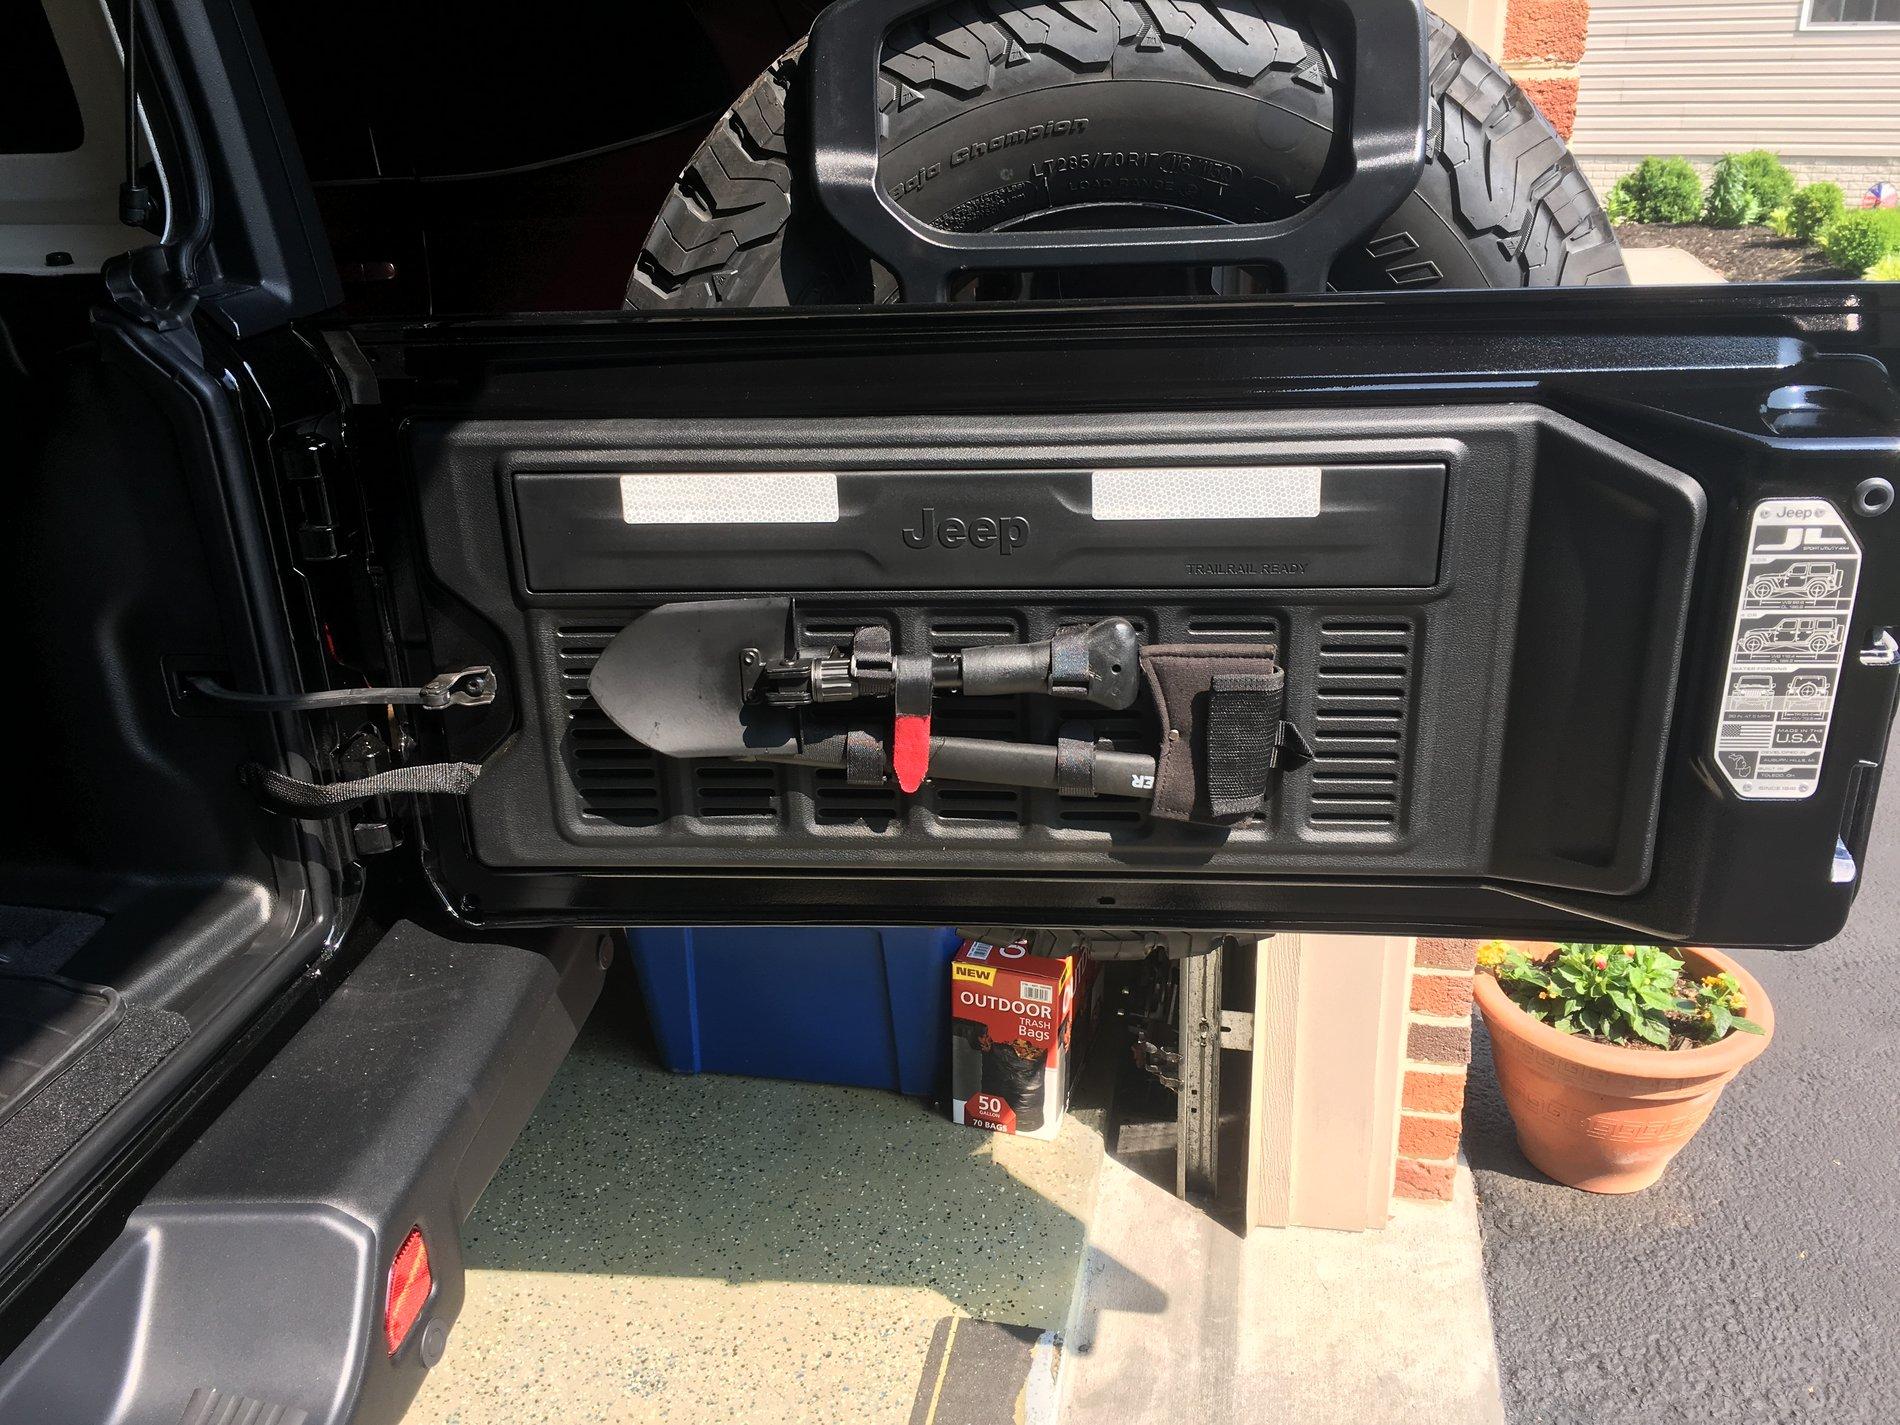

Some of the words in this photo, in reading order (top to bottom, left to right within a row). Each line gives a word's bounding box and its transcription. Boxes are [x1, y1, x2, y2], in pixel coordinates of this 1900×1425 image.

[950, 118, 1090, 168] Champion
[1777, 507, 1813, 519] Jeep
[902, 507, 1031, 556] Jeep
[1185, 563, 1258, 576] TRAILRAIL
[1261, 562, 1311, 575] READY
[1776, 733, 1821, 743] U.S.A.
[955, 966, 991, 981] NEW
[960, 991, 1052, 1019] OUTDOOR
[1020, 1017, 1051, 1030] TRASH
[1018, 1025, 1050, 1041] Bags
[979, 1095, 1001, 1113] 50
[979, 1110, 1000, 1118] GALLON
[973, 1118, 983, 1127] 70
[985, 1121, 1008, 1133] BAGS
